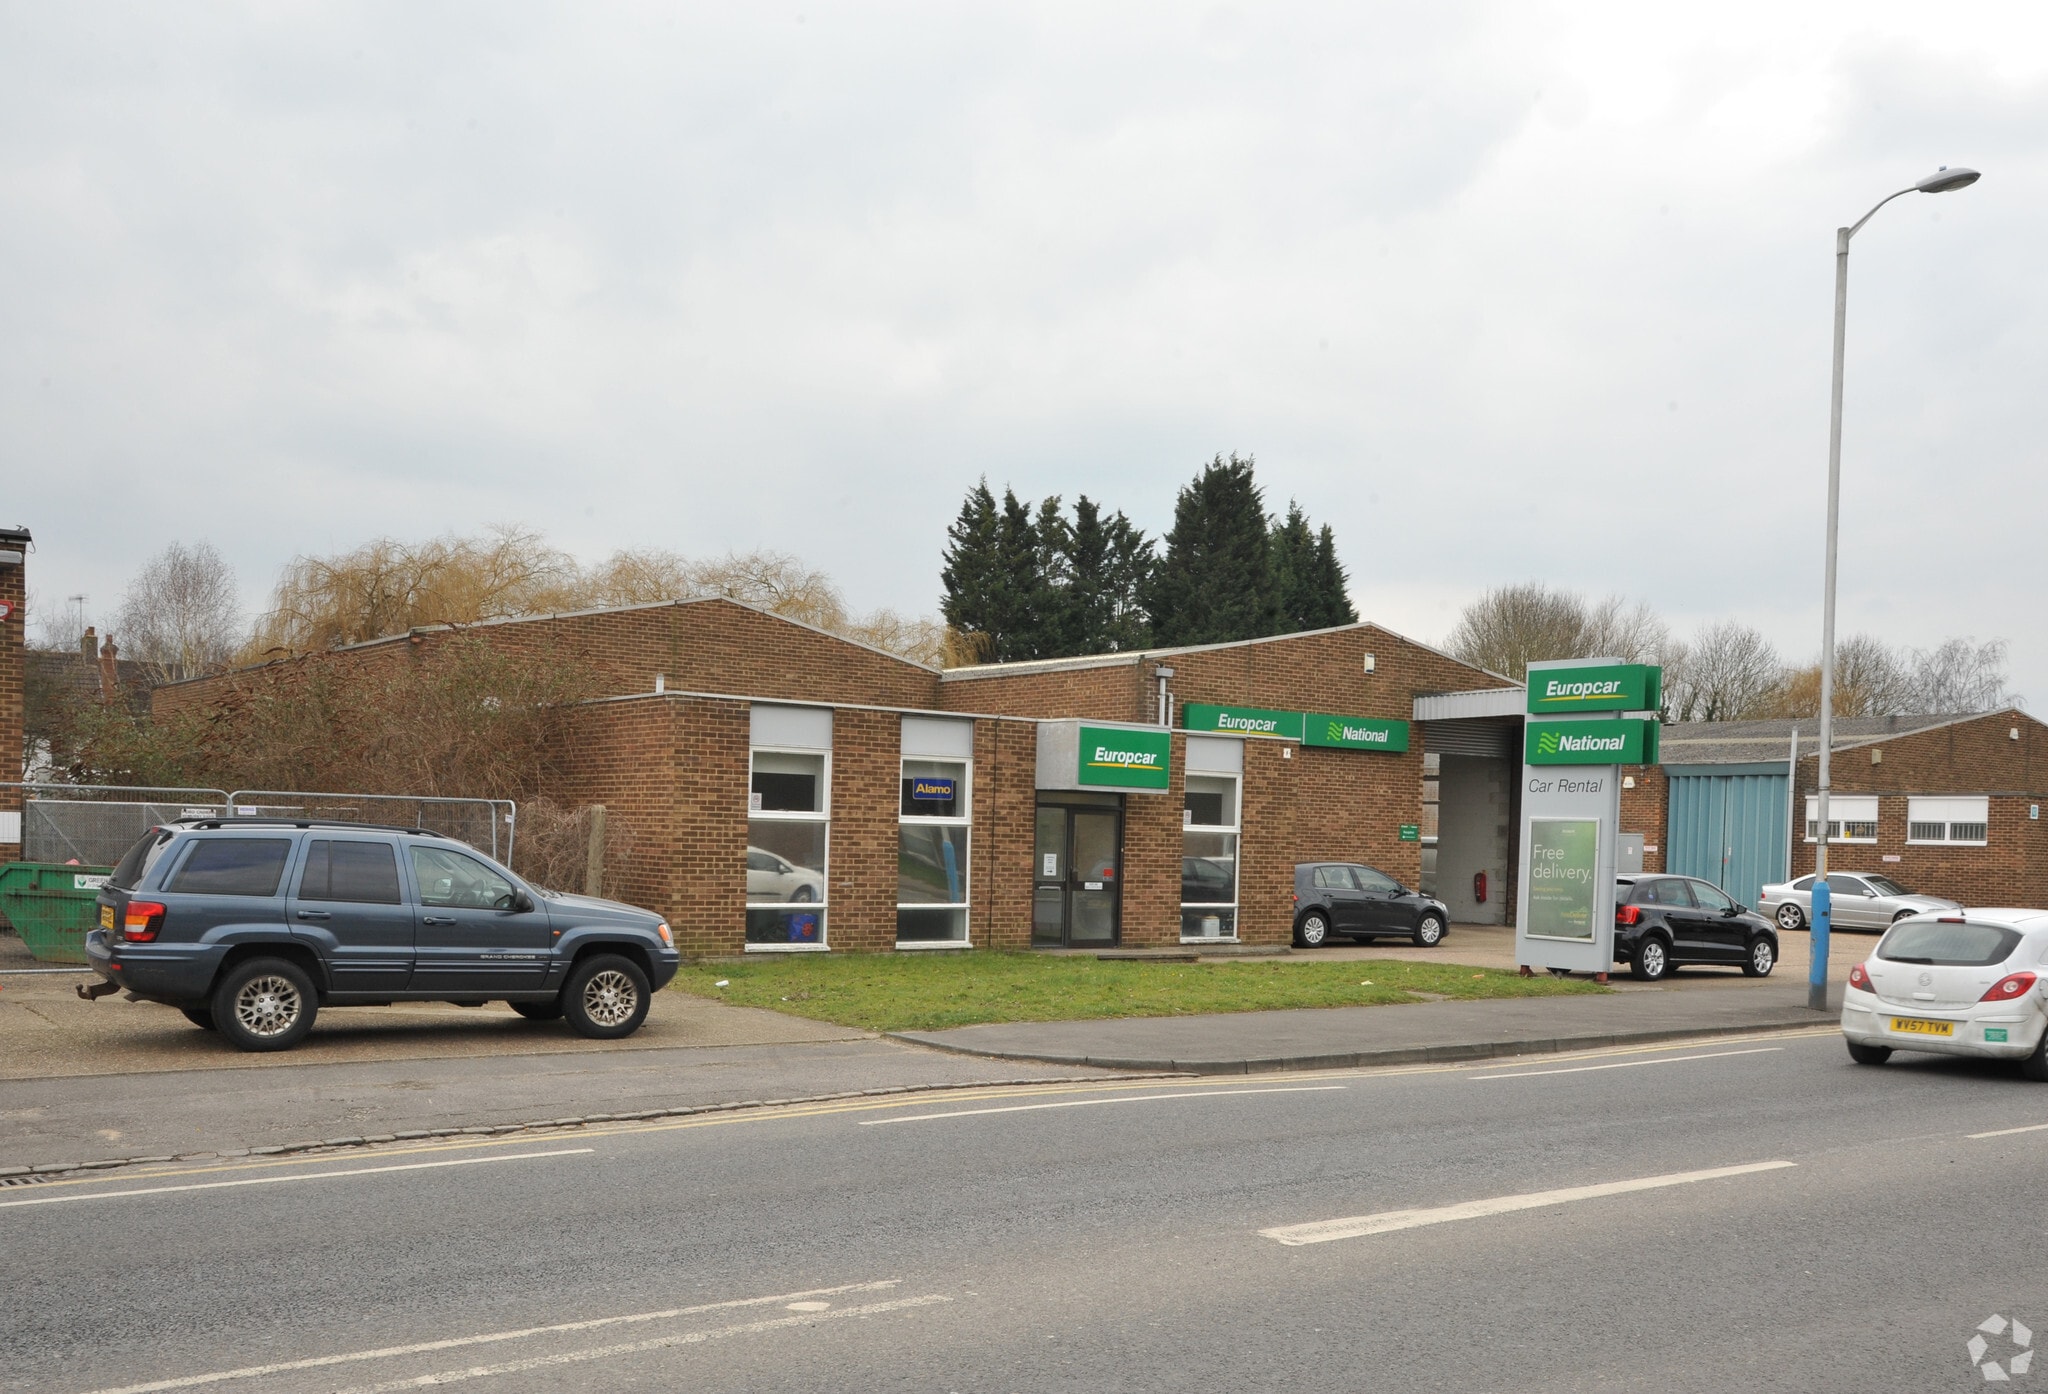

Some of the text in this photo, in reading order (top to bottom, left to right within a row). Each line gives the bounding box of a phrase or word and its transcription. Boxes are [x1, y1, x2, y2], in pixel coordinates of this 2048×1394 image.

[1546, 680, 1621, 699] Europcar
[1218, 713, 1277, 734] Europcar
[1342, 726, 1388, 742] National
[1559, 734, 1625, 751] National
[1094, 746, 1157, 768] Europcar
[915, 783, 951, 794] Alamo
[1528, 778, 1603, 793] Car Rental
[1533, 844, 1565, 860] Free
[1533, 862, 1592, 884] delivery.
